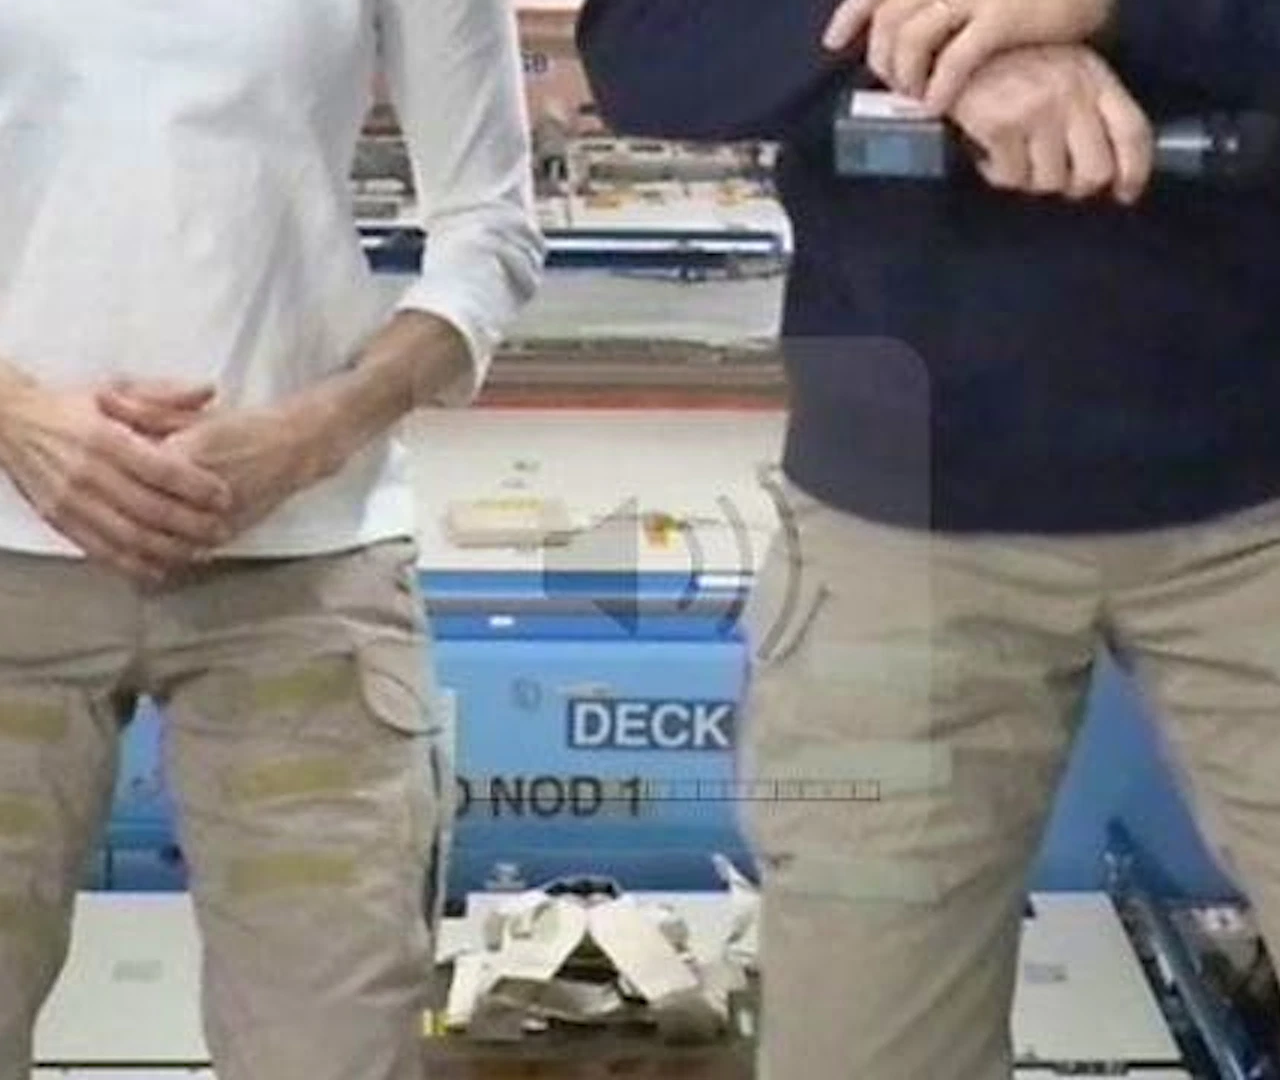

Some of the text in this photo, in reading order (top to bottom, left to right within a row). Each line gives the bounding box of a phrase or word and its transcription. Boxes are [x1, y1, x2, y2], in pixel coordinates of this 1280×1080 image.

[573, 701, 730, 748] DECK
[489, 775, 603, 818] NOD
[621, 775, 641, 818] 1
